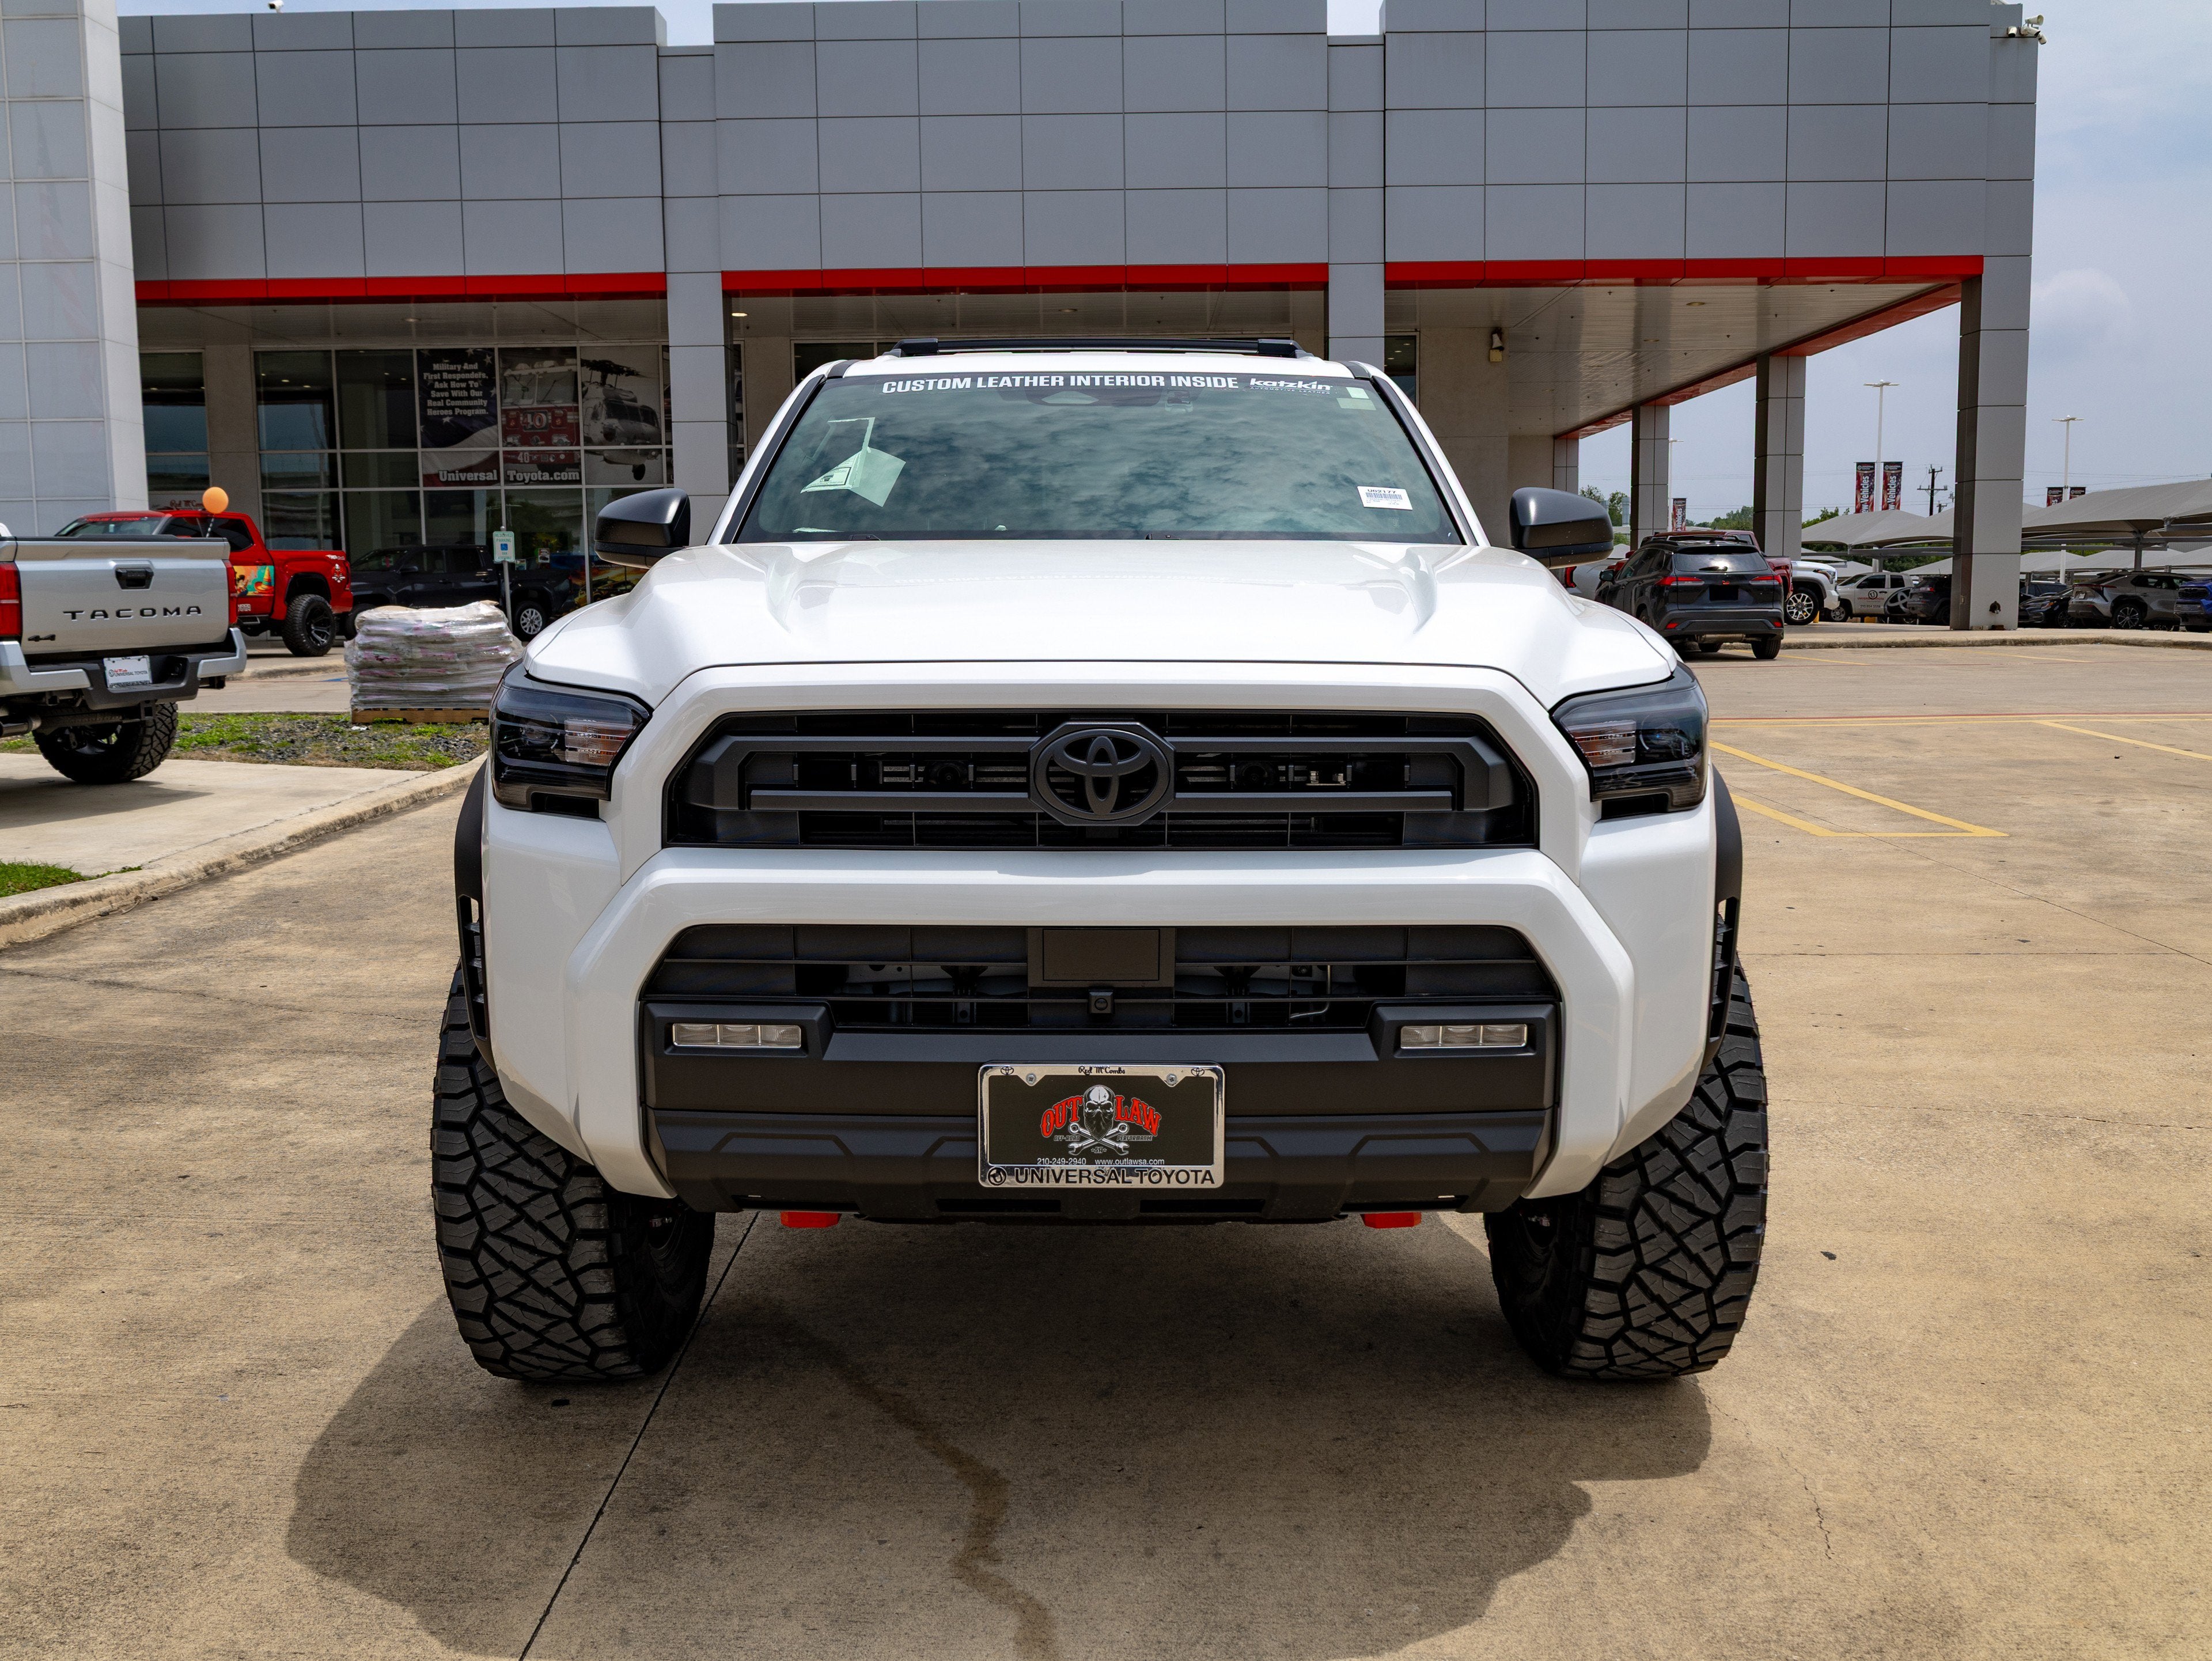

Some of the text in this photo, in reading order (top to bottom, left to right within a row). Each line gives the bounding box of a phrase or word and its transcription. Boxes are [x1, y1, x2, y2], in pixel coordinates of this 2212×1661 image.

[433, 363, 461, 371] Military
[442, 372, 488, 380] Responders,
[882, 375, 1239, 394] CUSTOM LEATHER INTERIOR INSIDE
[1249, 378, 1331, 391] katzkin
[446, 398, 488, 407] Community
[454, 408, 488, 417] Program.
[520, 413, 547, 429] 40
[517, 452, 530, 463] 40
[439, 470, 580, 483] Universal Toyota.com
[1860, 476, 1869, 503] Vehicles
[1887, 475, 1896, 504] Vehicles
[63, 606, 202, 620] TACOMA
[1078, 1065, 1126, 1076] Red McCombs
[1014, 1169, 1215, 1185] UNIVERSAL TOYOTA
